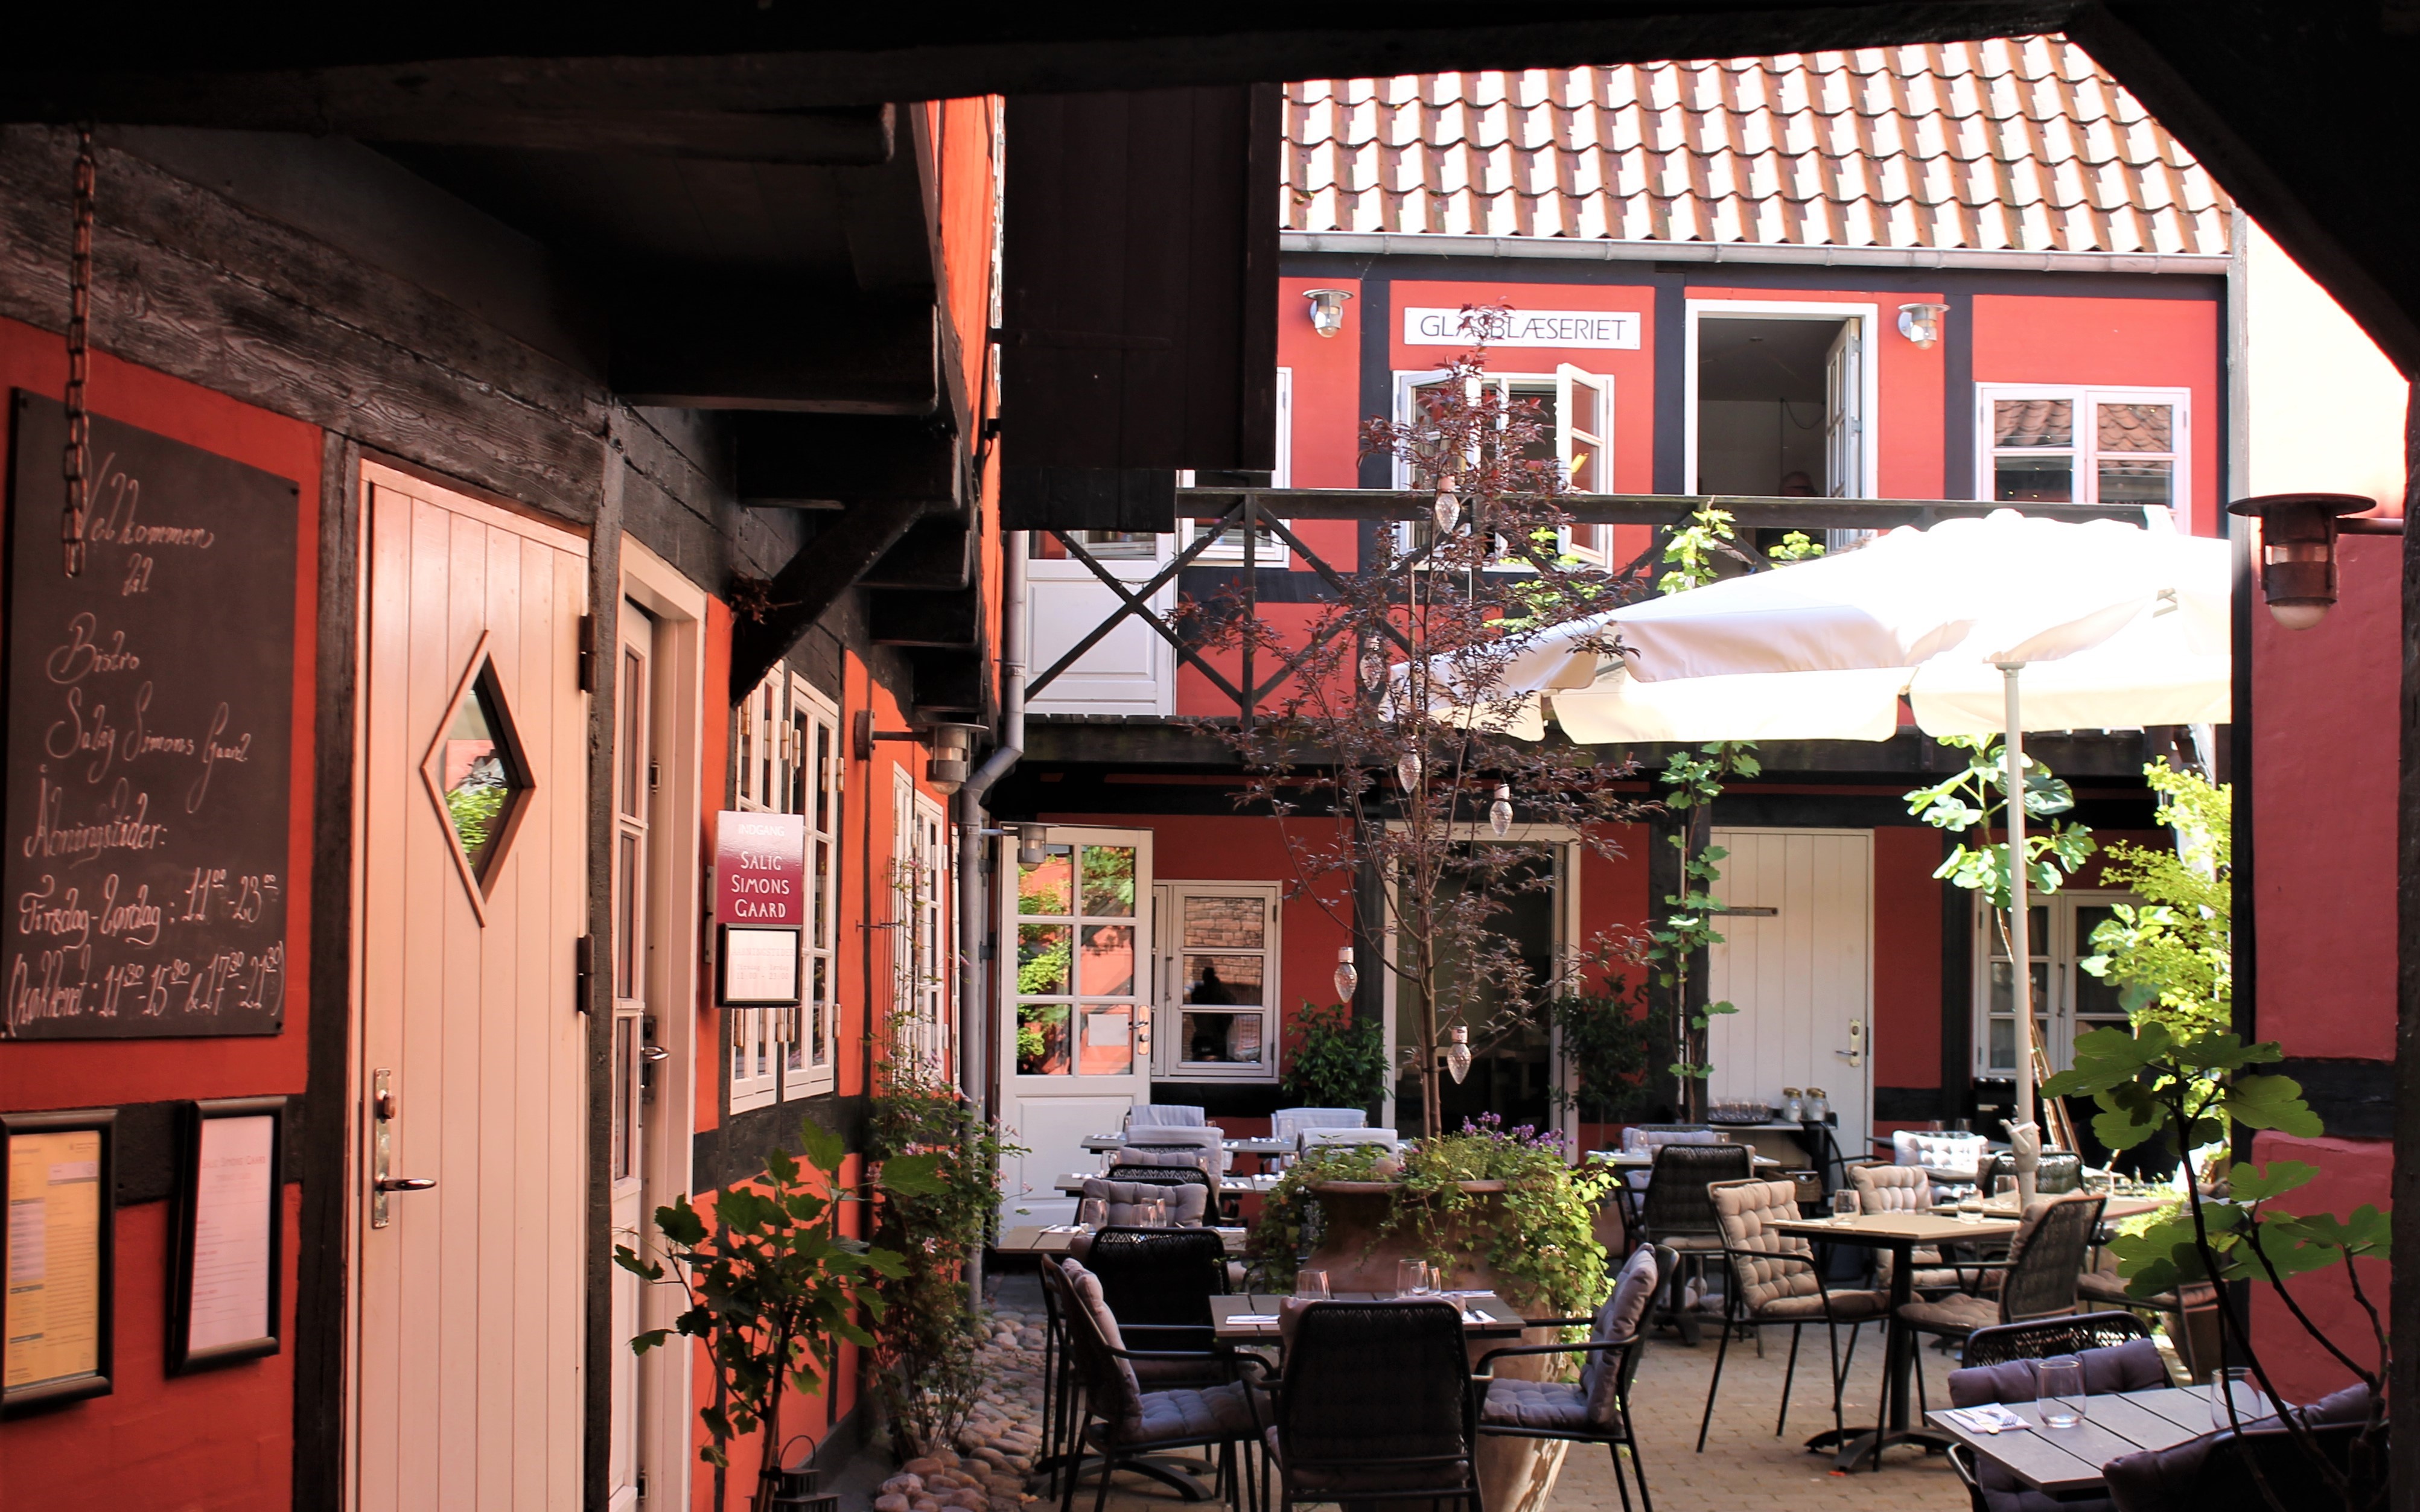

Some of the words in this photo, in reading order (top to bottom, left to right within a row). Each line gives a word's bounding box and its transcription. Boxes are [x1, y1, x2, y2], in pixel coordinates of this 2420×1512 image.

[81, 451, 215, 548] Velkommen
[123, 553, 153, 597] til
[46, 612, 140, 684] Bistro
[45, 687, 116, 783] Salig
[123, 681, 195, 761] Simons
[738, 824, 785, 837] INDGANG
[740, 851, 782, 871] SALIG
[731, 874, 790, 895] SIMONS
[734, 898, 786, 918] GAARD
